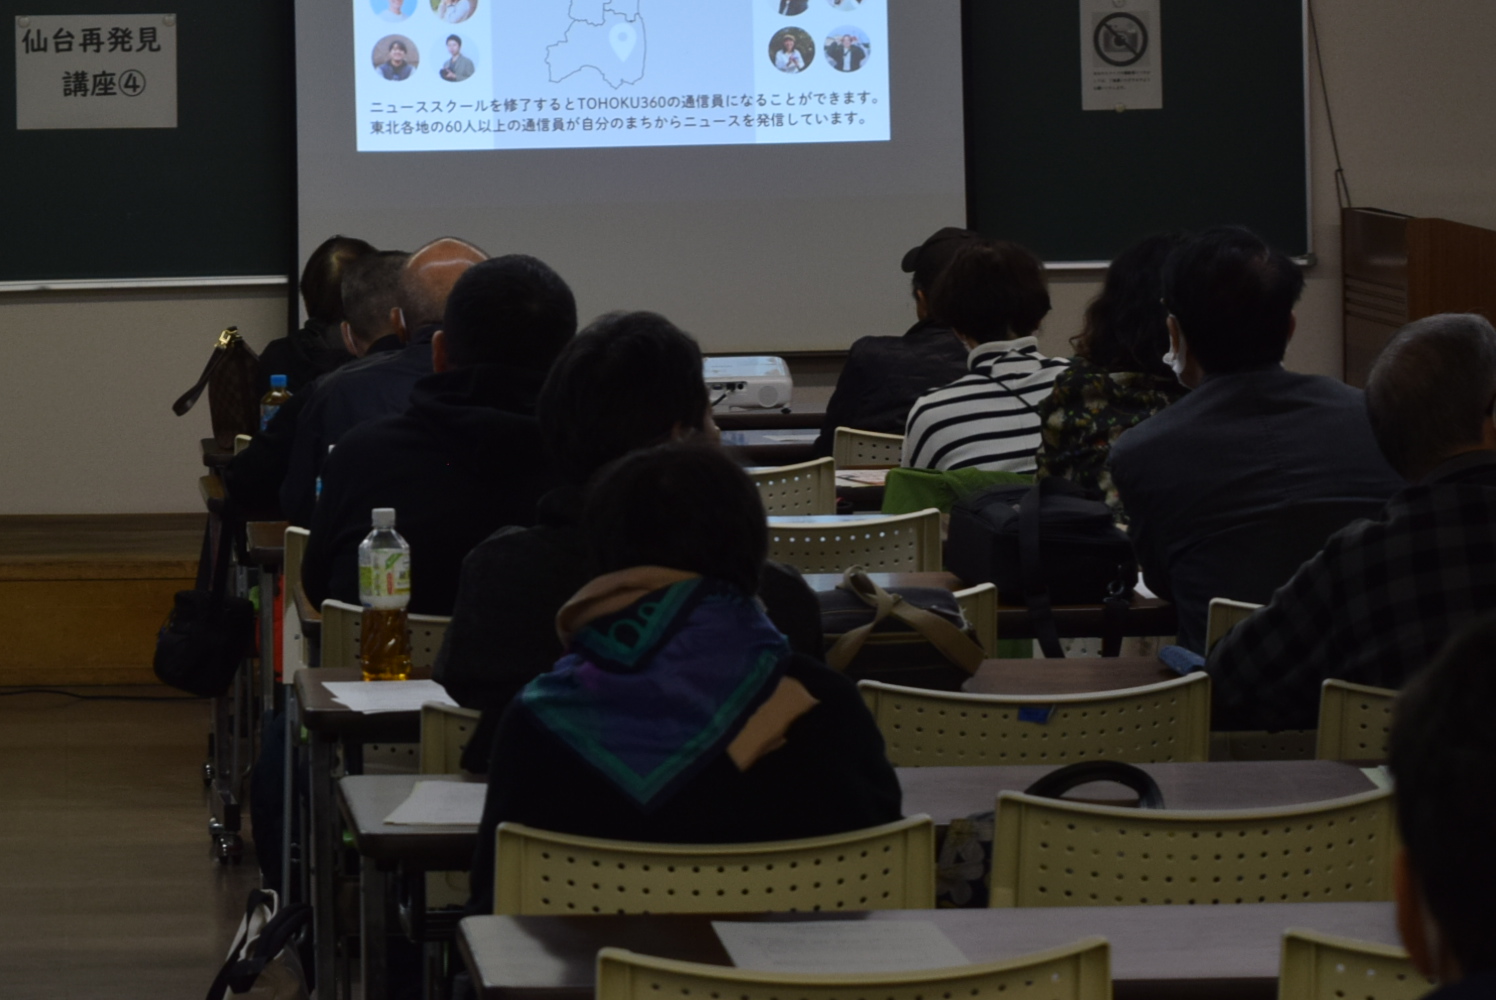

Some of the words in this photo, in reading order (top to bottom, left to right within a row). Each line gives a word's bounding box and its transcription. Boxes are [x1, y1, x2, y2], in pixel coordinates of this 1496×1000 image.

[22, 27, 161, 54] 仙台再発見
[62, 69, 146, 97] 講座④
[370, 112, 866, 135] 東北各地の60人以上の通信員が自分のまちからニュースを発信しています。
